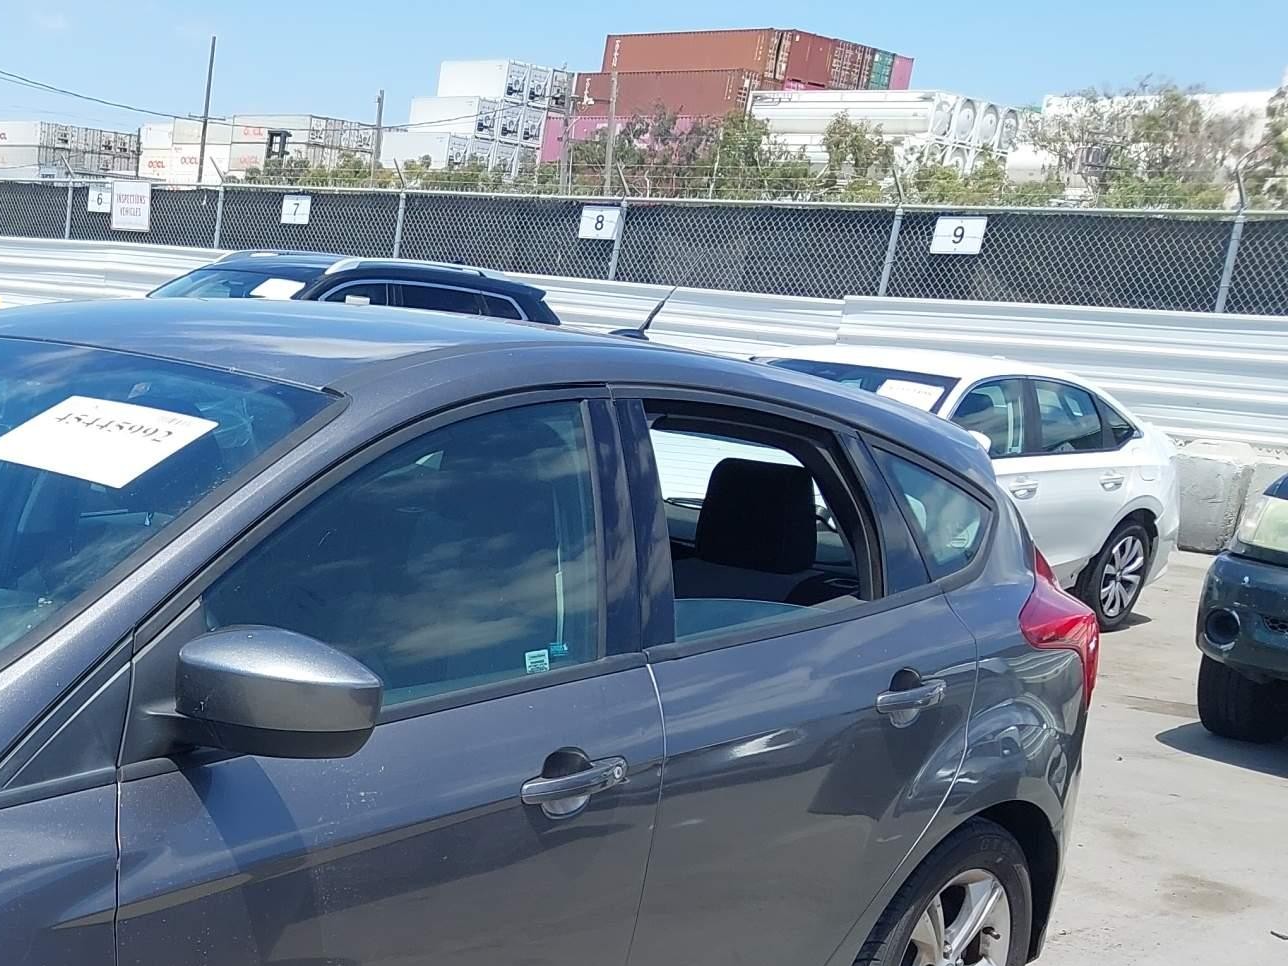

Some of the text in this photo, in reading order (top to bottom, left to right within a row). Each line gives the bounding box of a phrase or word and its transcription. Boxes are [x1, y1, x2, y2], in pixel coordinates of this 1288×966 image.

[96, 193, 103, 206] 6
[292, 202, 300, 216] 7
[594, 214, 604, 231] 8
[951, 226, 965, 244] 9
